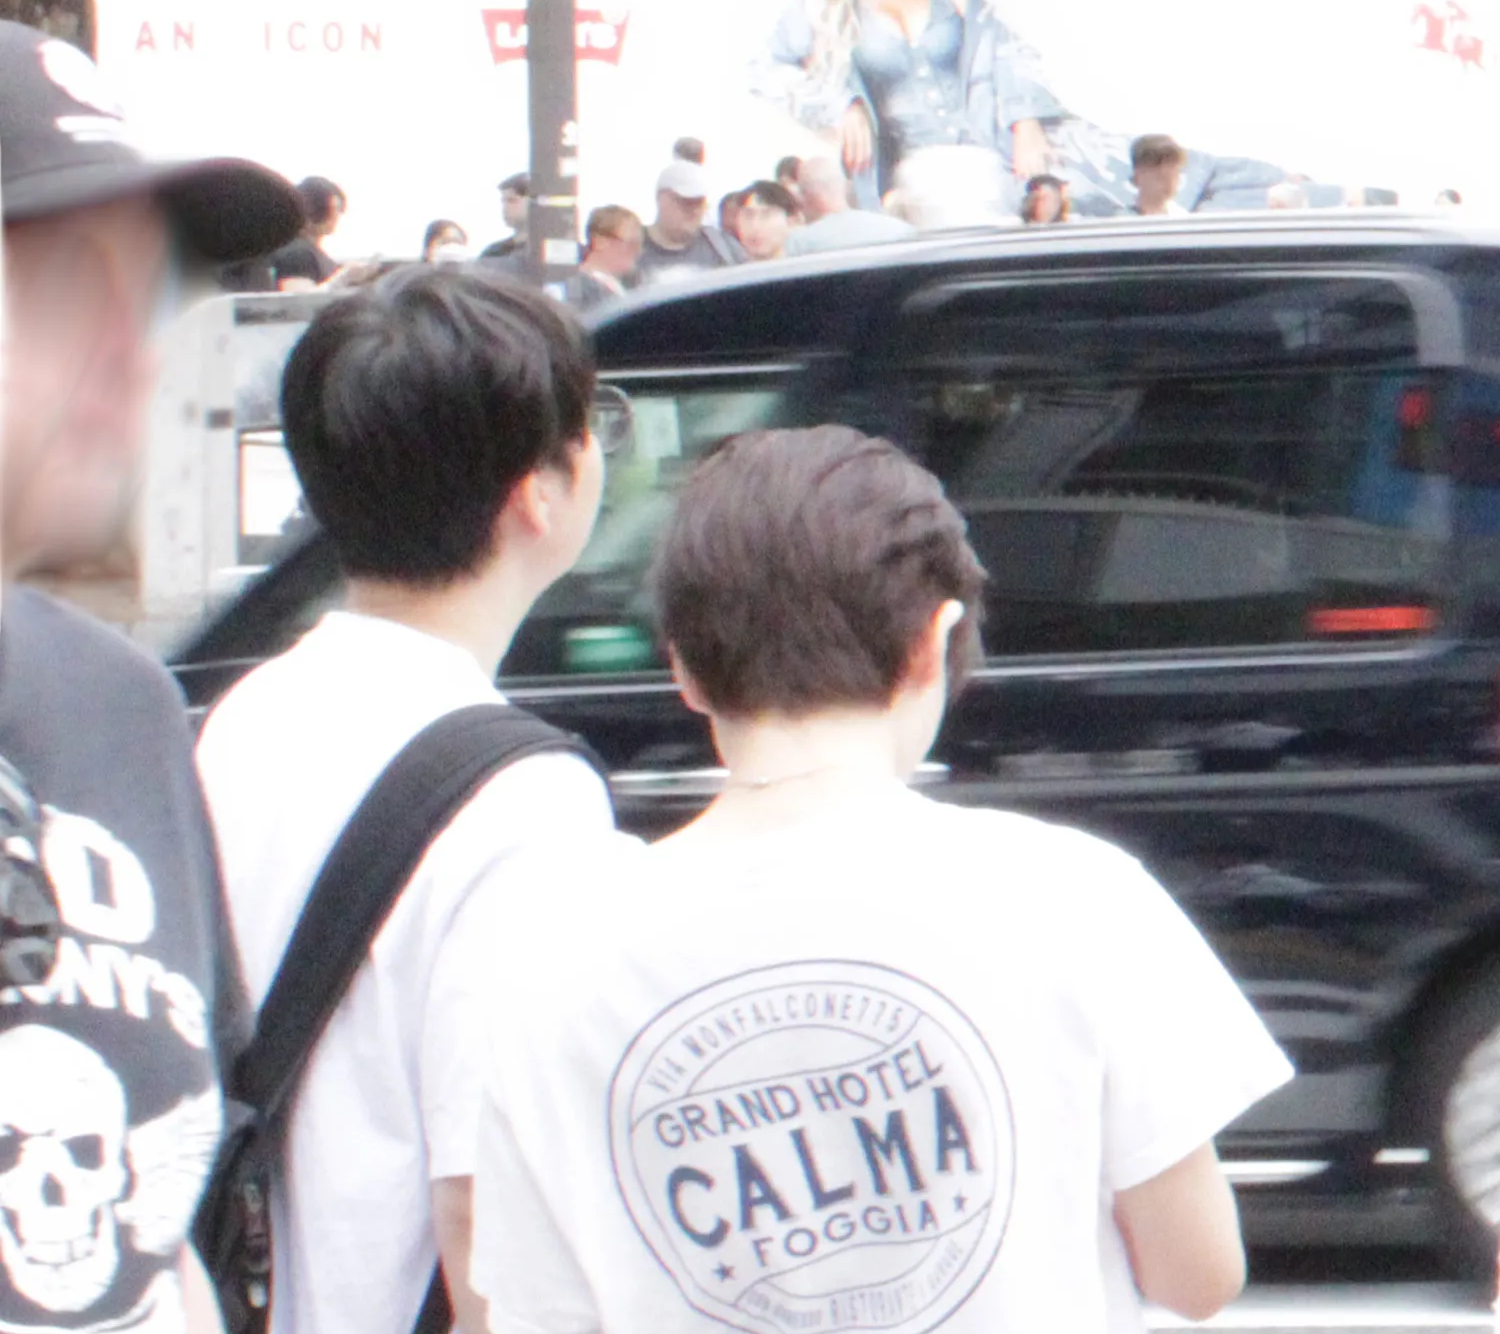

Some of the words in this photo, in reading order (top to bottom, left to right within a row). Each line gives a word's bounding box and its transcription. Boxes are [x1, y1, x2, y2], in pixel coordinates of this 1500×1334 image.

[134, 19, 195, 53] AN
[263, 21, 383, 53] ICON
[648, 1055, 689, 1095] VIA
[652, 1083, 803, 1149] GRAND
[805, 1039, 945, 1112] HOTEL
[666, 1084, 983, 1250] CALMA
[751, 1198, 940, 1268] FOGGIA
